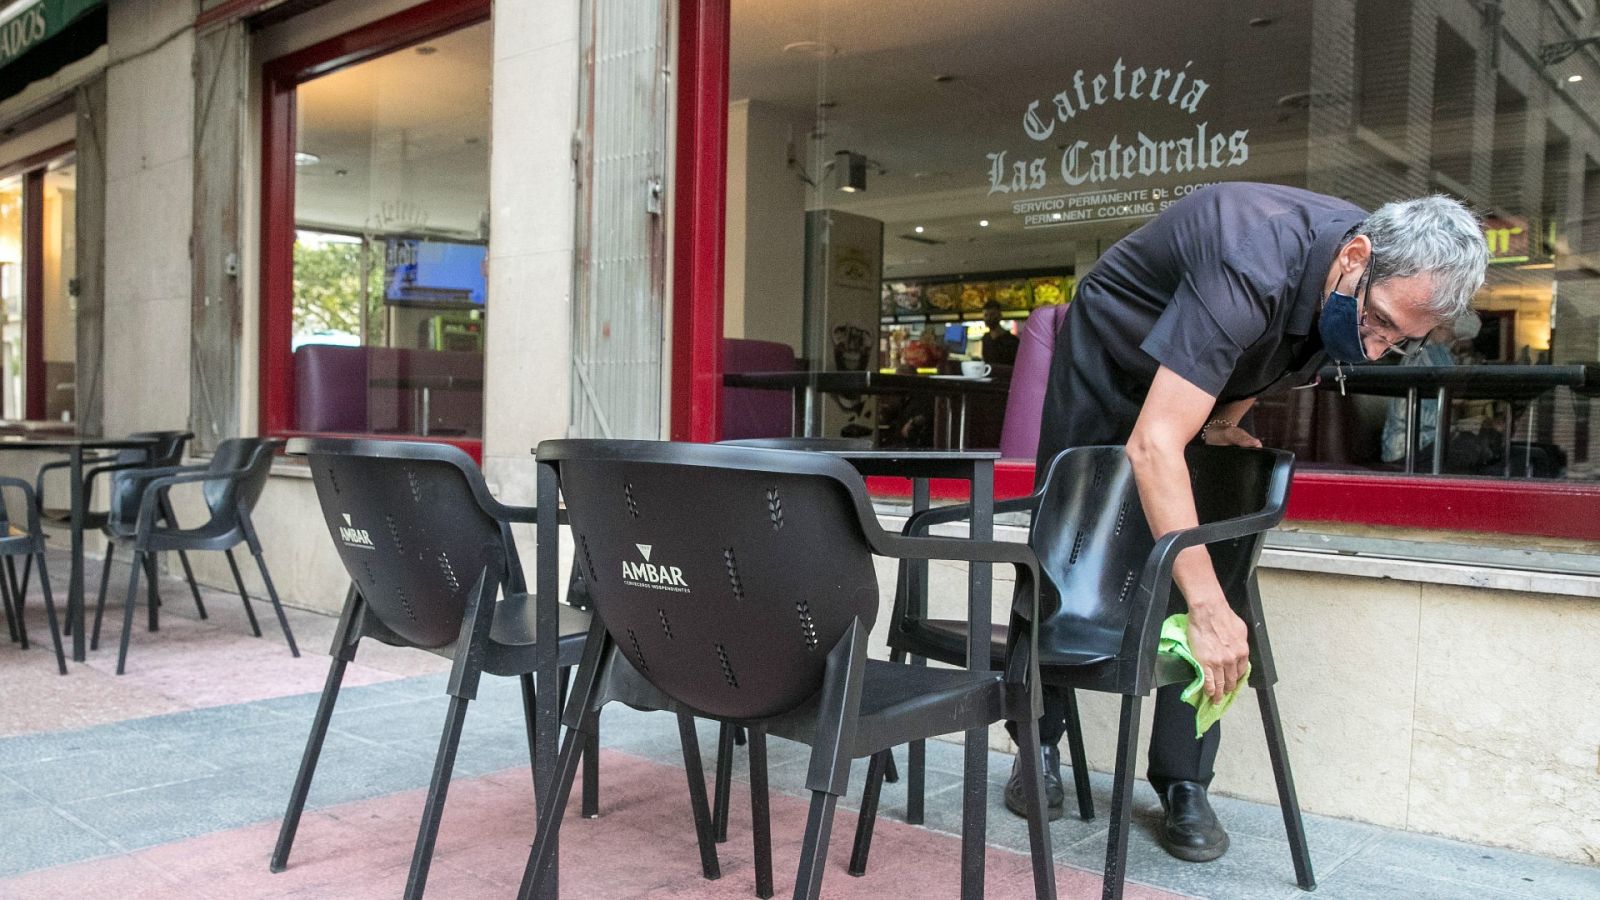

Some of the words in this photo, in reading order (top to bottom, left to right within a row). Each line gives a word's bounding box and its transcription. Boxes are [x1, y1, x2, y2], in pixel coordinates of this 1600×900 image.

[1023, 56, 1210, 141] Cafetería
[986, 150, 1046, 194] Las
[1061, 121, 1249, 186] Catedrales
[1013, 199, 1064, 214] SERVICIO
[1068, 190, 1148, 208] PERMANENTE
[1152, 188, 1169, 200] DE
[1098, 202, 1154, 217] COOKING
[339, 526, 374, 546] AMBAR
[622, 560, 688, 587] AMBAR
